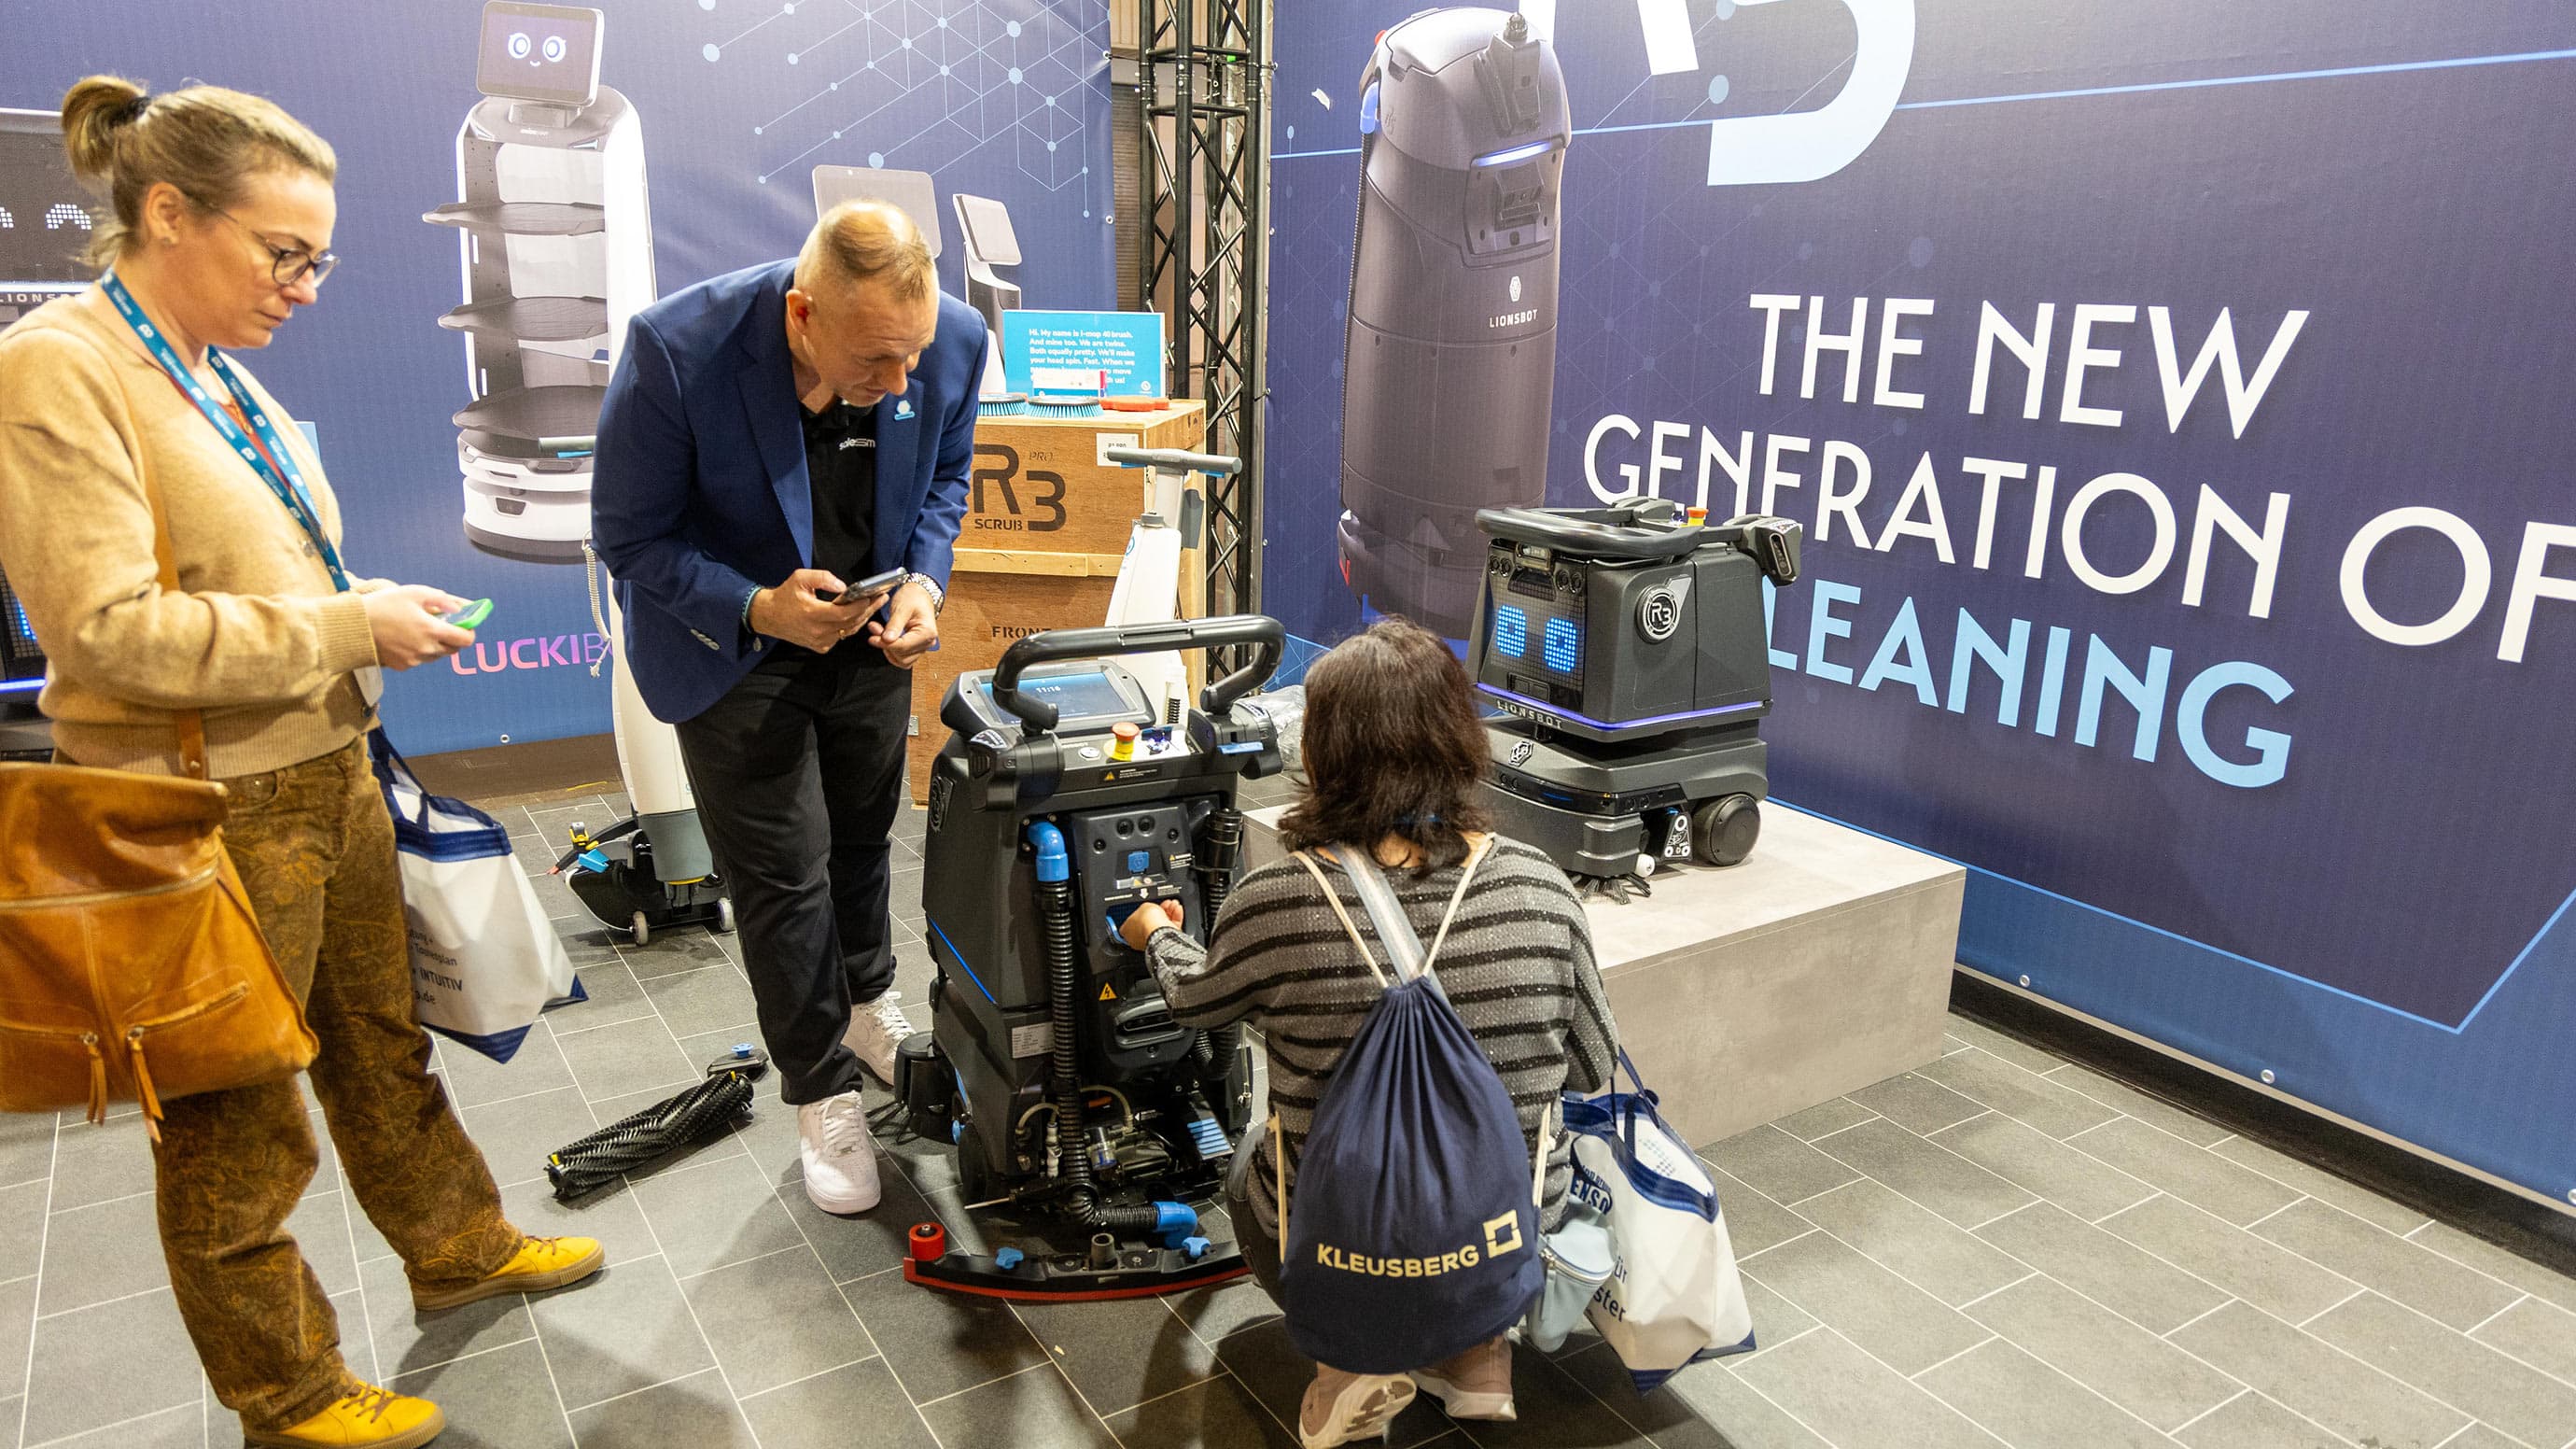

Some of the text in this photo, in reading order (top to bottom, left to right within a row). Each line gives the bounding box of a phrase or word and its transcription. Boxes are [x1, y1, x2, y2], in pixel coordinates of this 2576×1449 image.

[1489, 308, 1538, 328] LIONSBOT
[1749, 293, 2309, 441] THE NEW
[1029, 451, 1055, 463] PRO
[973, 443, 1067, 532] R3
[974, 518, 1023, 531] SCRUB
[1583, 415, 2576, 663] GENERATION OF
[1652, 602, 1672, 626] R3
[450, 632, 614, 676] LUCKIB
[1762, 574, 2294, 788] LEANING
[1497, 700, 1561, 729] LIONSBOT
[1317, 1243, 1479, 1278] KLEUSBERG
[1614, 1256, 1628, 1284] ür
[1593, 1286, 1626, 1323] ster
